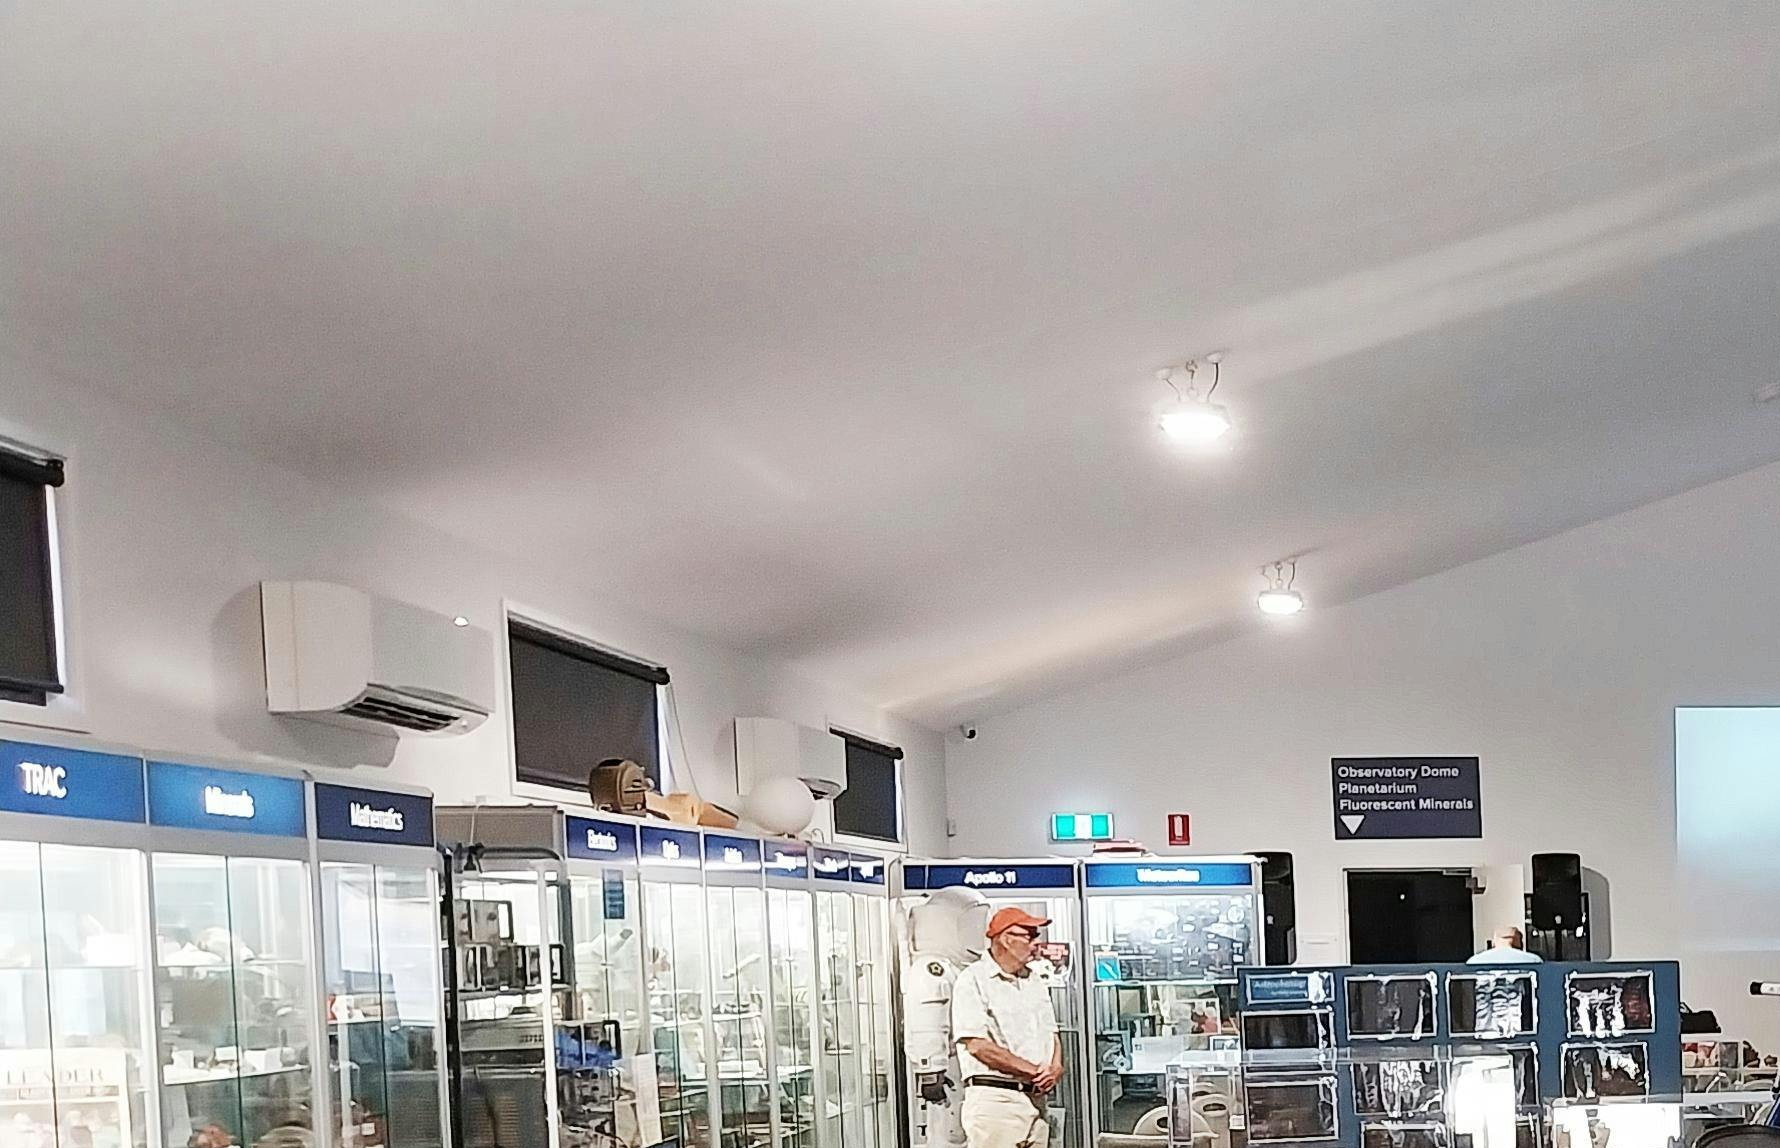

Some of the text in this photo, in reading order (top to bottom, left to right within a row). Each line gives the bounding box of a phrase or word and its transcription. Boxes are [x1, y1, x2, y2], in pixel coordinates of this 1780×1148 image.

[1337, 766, 1460, 779] Observatory Dome
[19, 761, 67, 798] TRAC
[1338, 782, 1417, 794] Planetarium
[1339, 798, 1474, 810] Fluorescent Minerals
[964, 870, 1017, 886] Apollo 11
